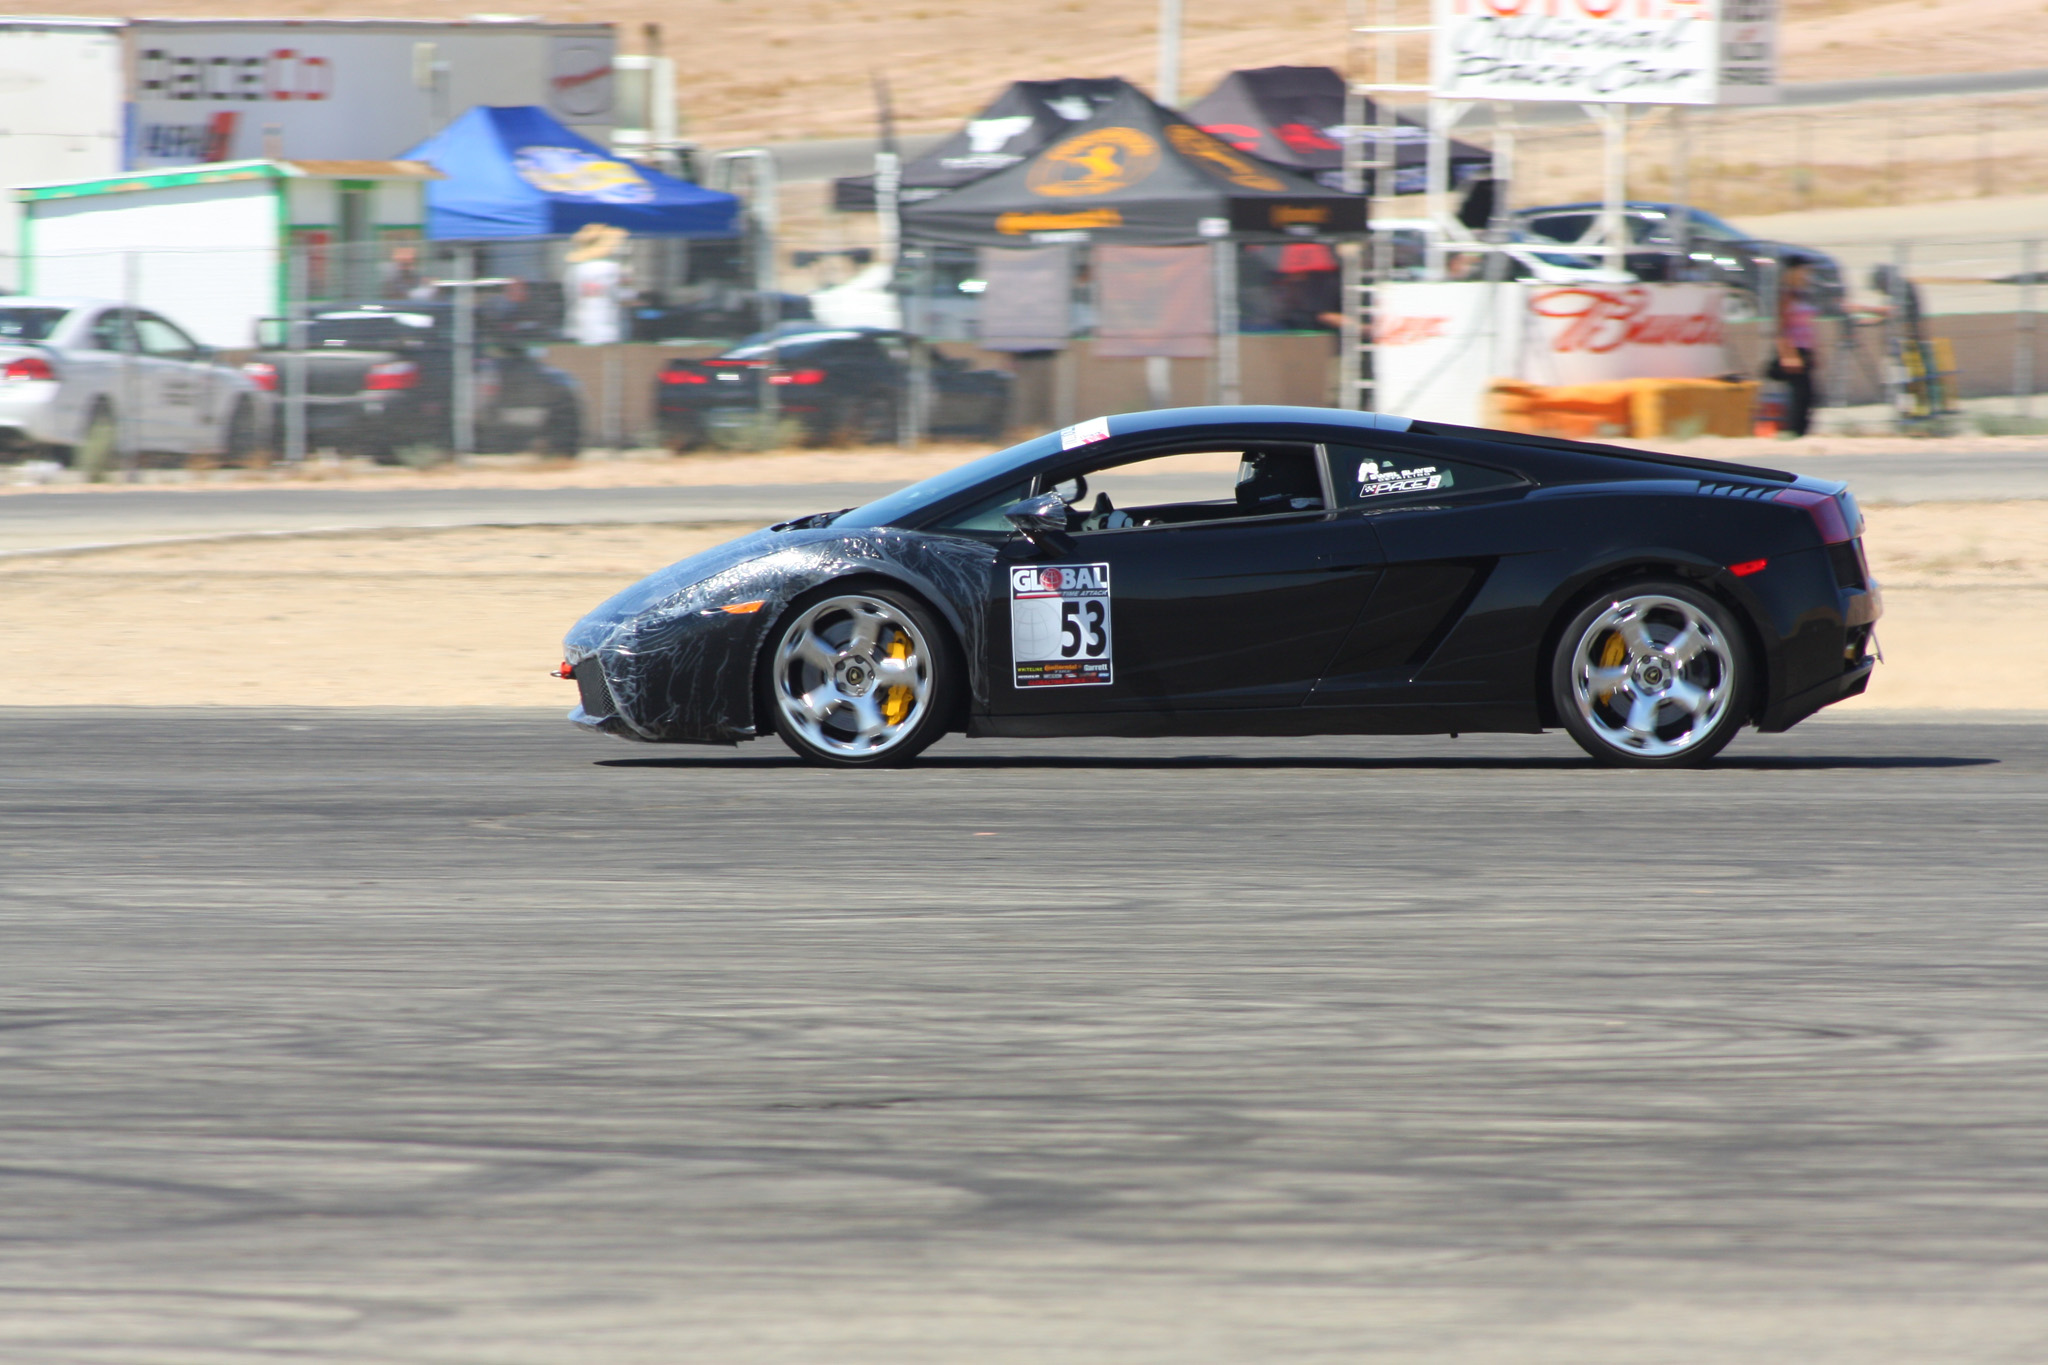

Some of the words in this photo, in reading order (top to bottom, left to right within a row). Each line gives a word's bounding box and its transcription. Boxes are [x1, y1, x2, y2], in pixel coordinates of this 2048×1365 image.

[1376, 478, 1428, 493] PACE
[1013, 567, 1107, 591] GLOBAL
[1061, 600, 1106, 658] 53
